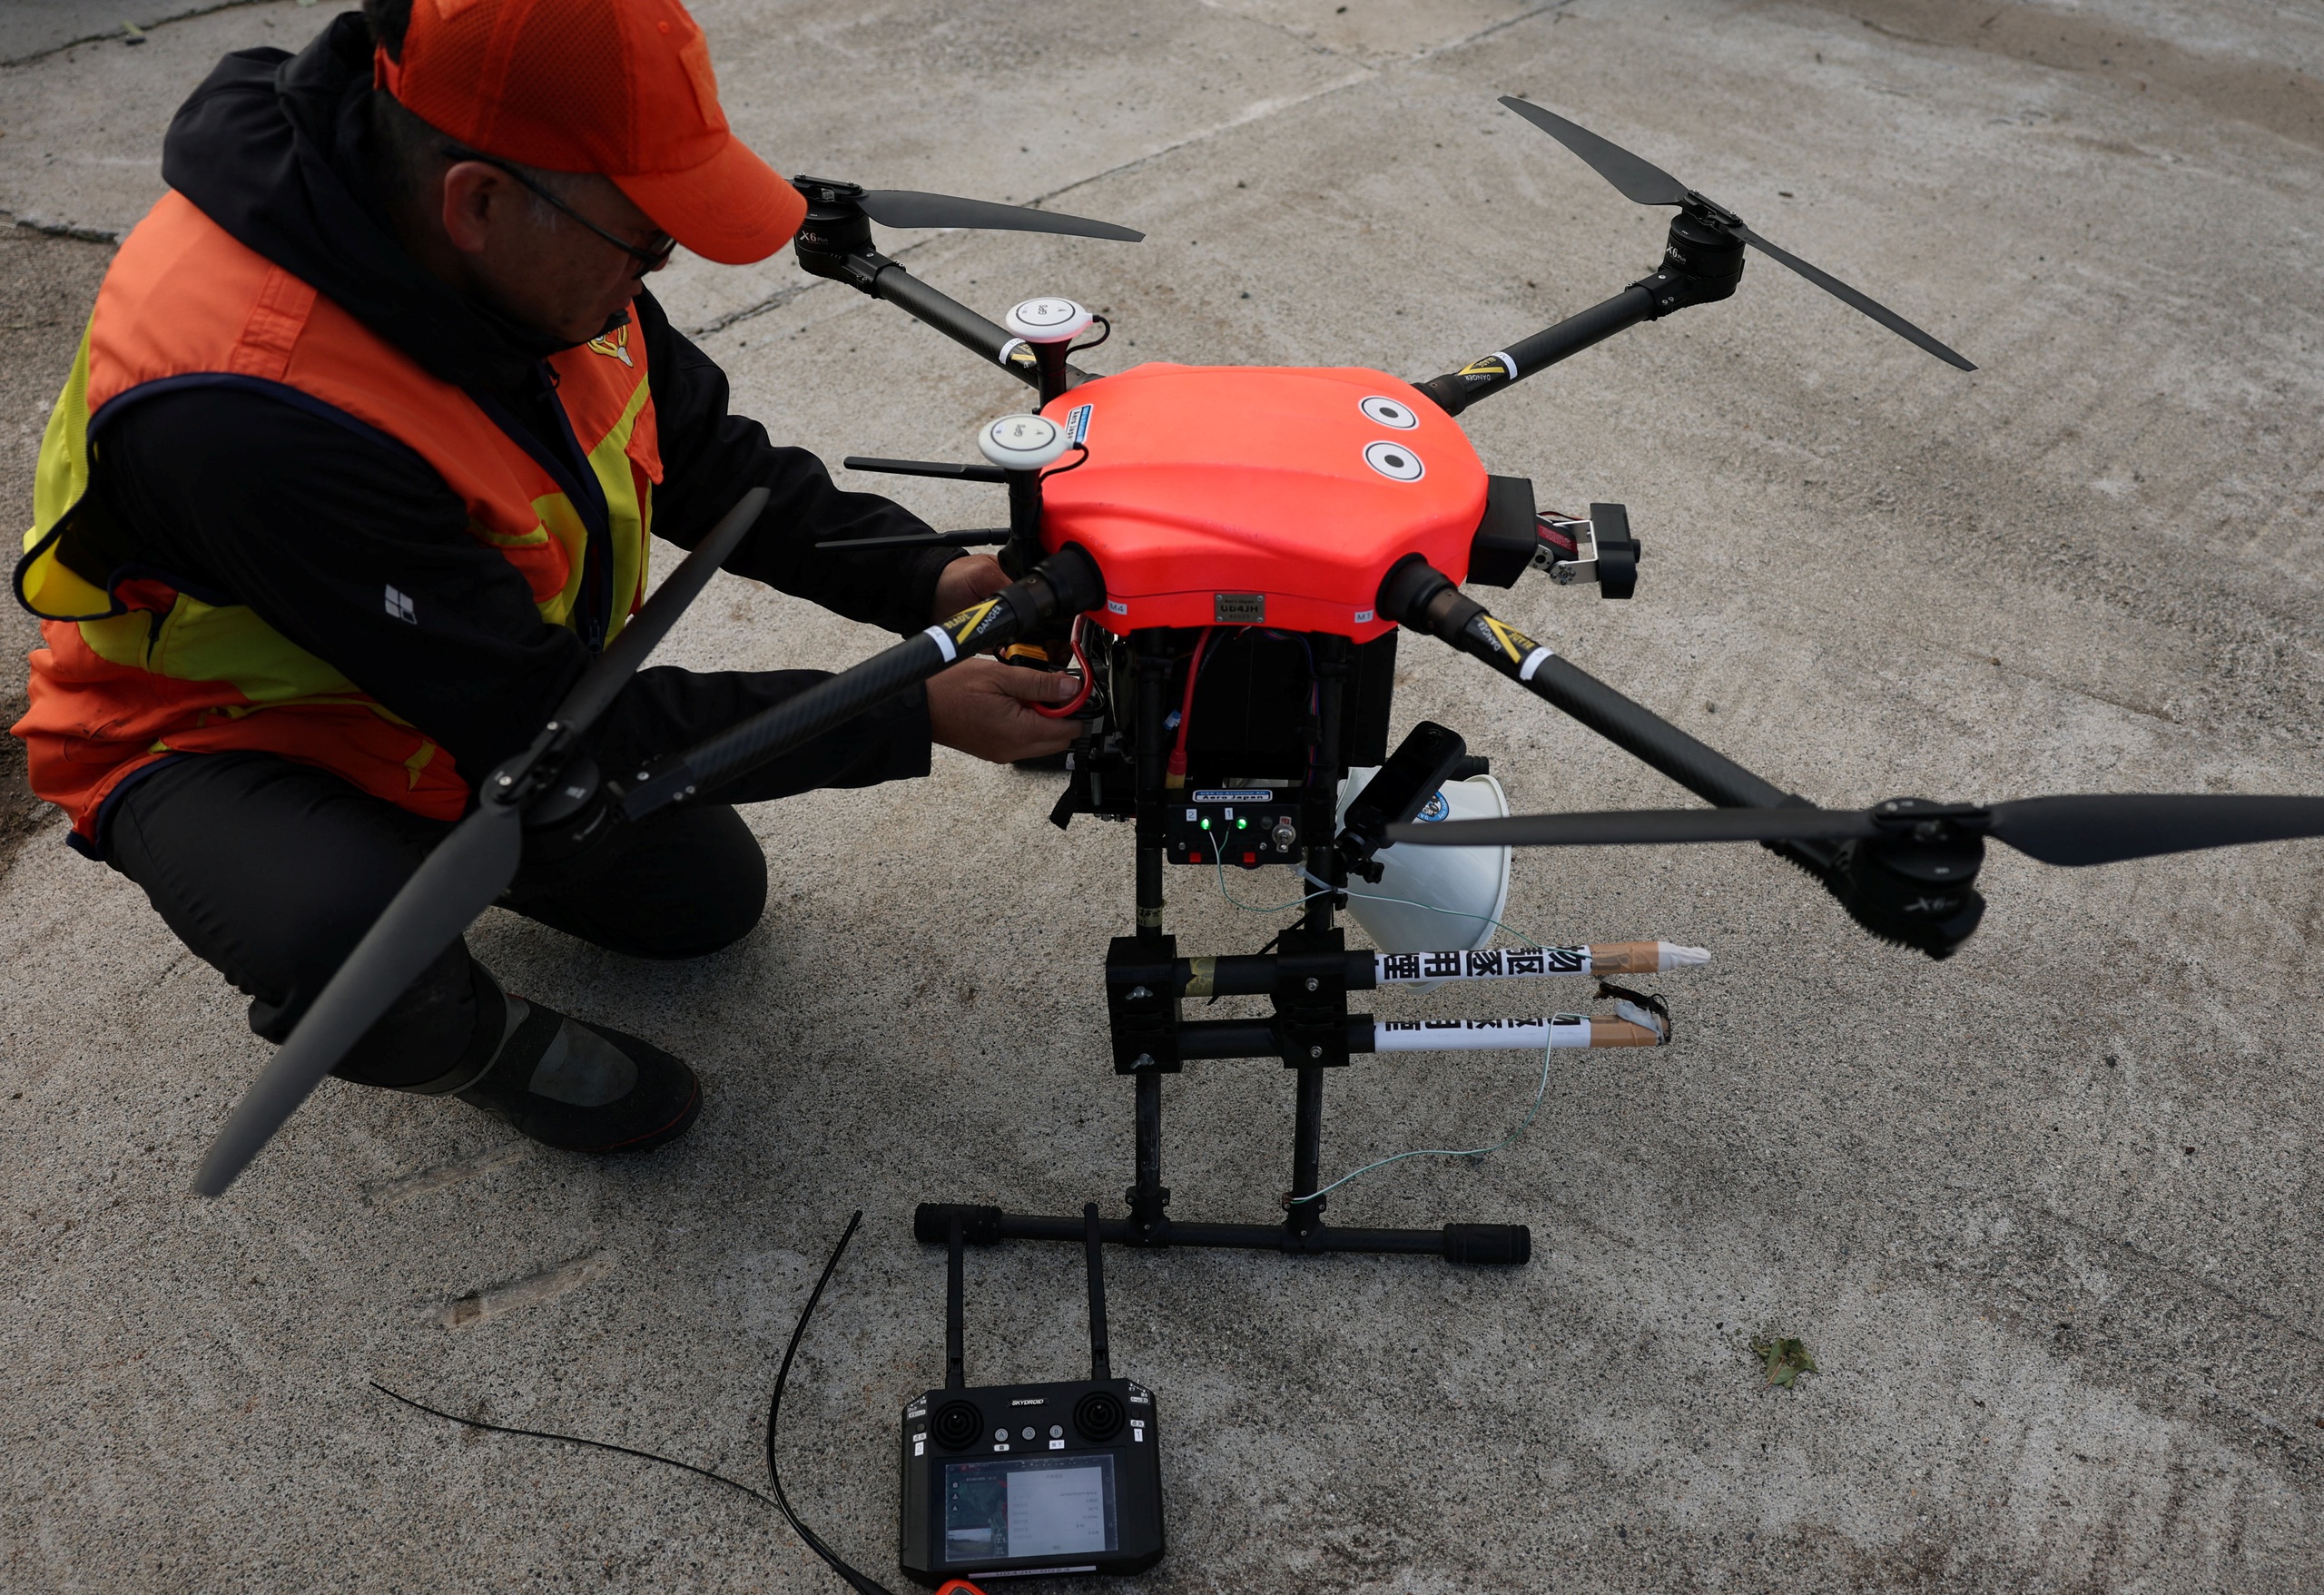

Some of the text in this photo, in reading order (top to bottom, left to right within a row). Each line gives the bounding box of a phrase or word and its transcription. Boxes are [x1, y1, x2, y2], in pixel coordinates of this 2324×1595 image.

[1109, 604, 1125, 613] M4
[1357, 611, 1371, 621] M1
[977, 605, 1002, 635] DANGER
[1477, 621, 1502, 651] DANGER
